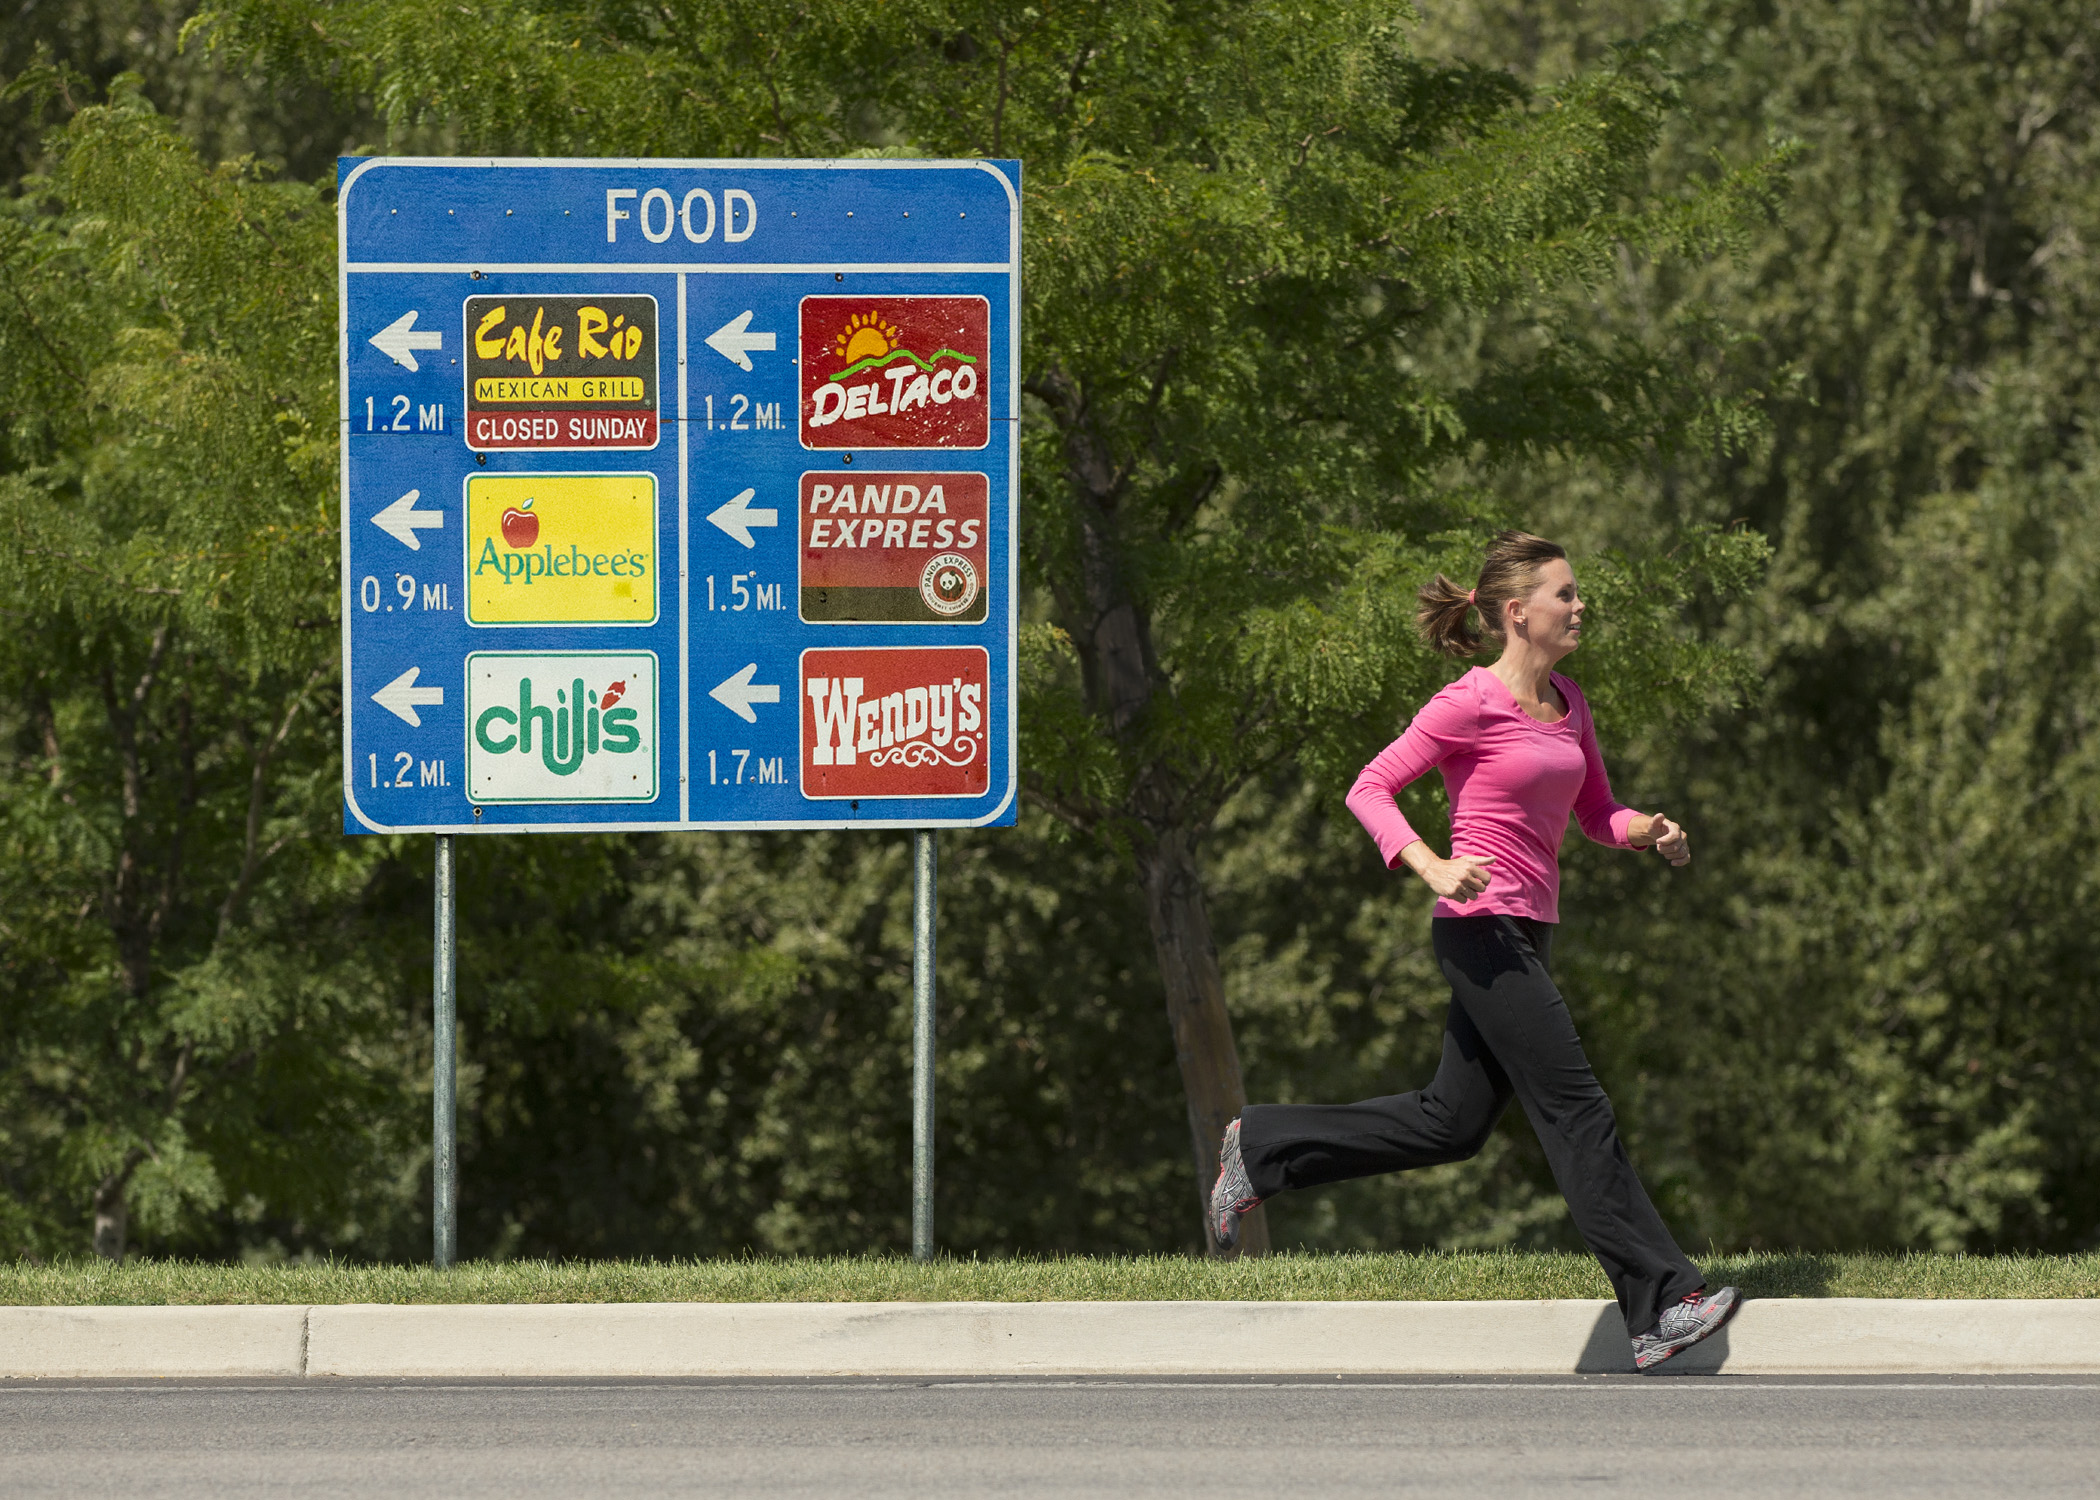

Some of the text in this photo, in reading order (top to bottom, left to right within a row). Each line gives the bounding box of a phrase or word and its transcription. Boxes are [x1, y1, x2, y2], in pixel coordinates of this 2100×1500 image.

[607, 188, 757, 243] FOOD
[475, 306, 642, 375] Cafe Rio
[479, 381, 639, 398] MEXICAN GRILL
[365, 395, 444, 431] 1.2 MI
[477, 418, 648, 440] CLOSED SUNDAY
[705, 394, 786, 430] 1.2 MI.
[810, 485, 947, 514] PANDA
[809, 519, 980, 549] EXPRESS
[475, 537, 646, 584] Applebee's
[925, 557, 973, 587] PANDA EXPRESS
[361, 575, 453, 612] 0.9 MI.
[706, 574, 787, 611] 1.5 MI.
[368, 752, 451, 788] 1.2 MI.
[708, 750, 789, 785] 1.7 MI.
